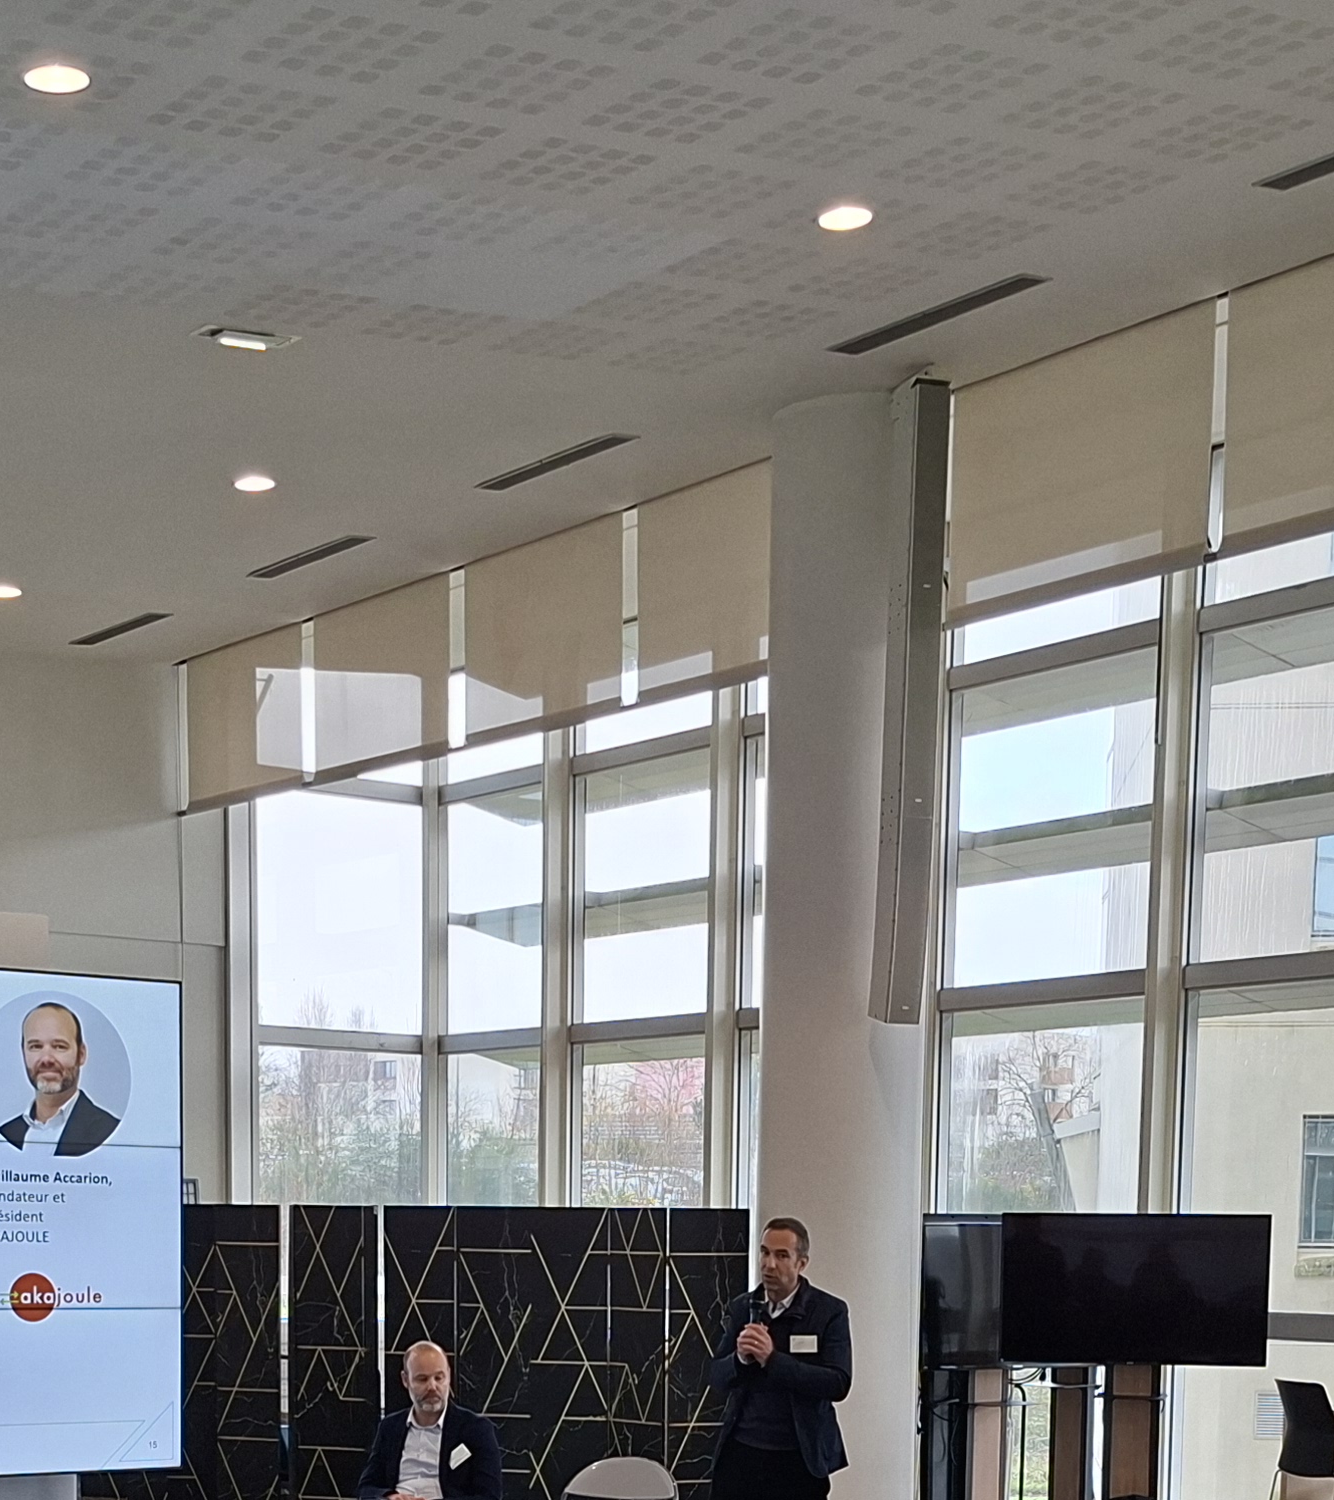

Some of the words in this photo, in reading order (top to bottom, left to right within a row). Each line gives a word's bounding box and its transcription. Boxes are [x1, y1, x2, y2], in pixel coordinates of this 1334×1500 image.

[53, 1172, 112, 1186] Accarion,
[53, 1192, 65, 1203] et
[20, 1285, 102, 1307] akajoule
[149, 1441, 158, 1449] 15
